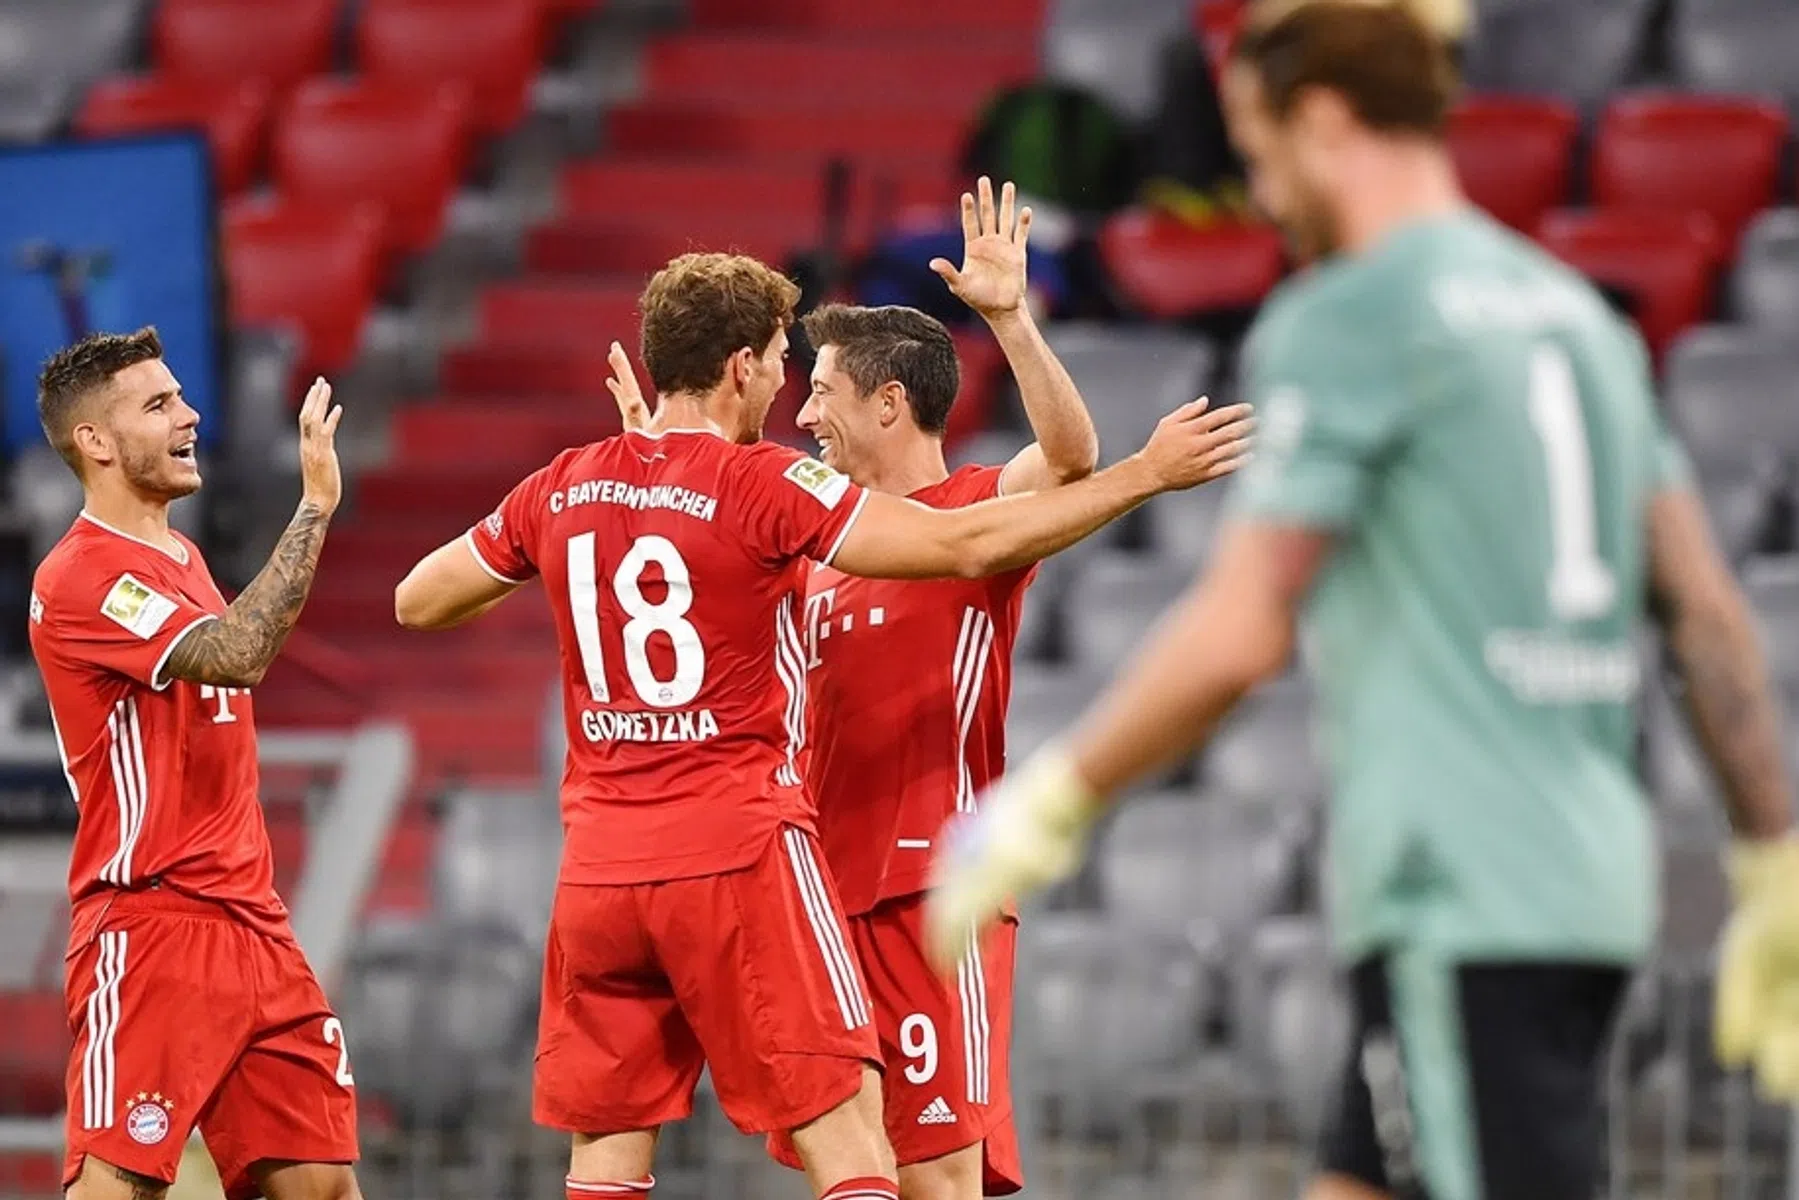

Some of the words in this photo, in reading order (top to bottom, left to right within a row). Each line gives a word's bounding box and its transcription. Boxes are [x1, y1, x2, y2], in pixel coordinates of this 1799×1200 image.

[567, 480, 639, 510] BAYERN
[1530, 340, 1617, 620] 1
[567, 531, 706, 707] 18
[581, 708, 720, 742] GORETZKA
[323, 1017, 355, 1087] 2
[900, 1013, 938, 1085] 9
